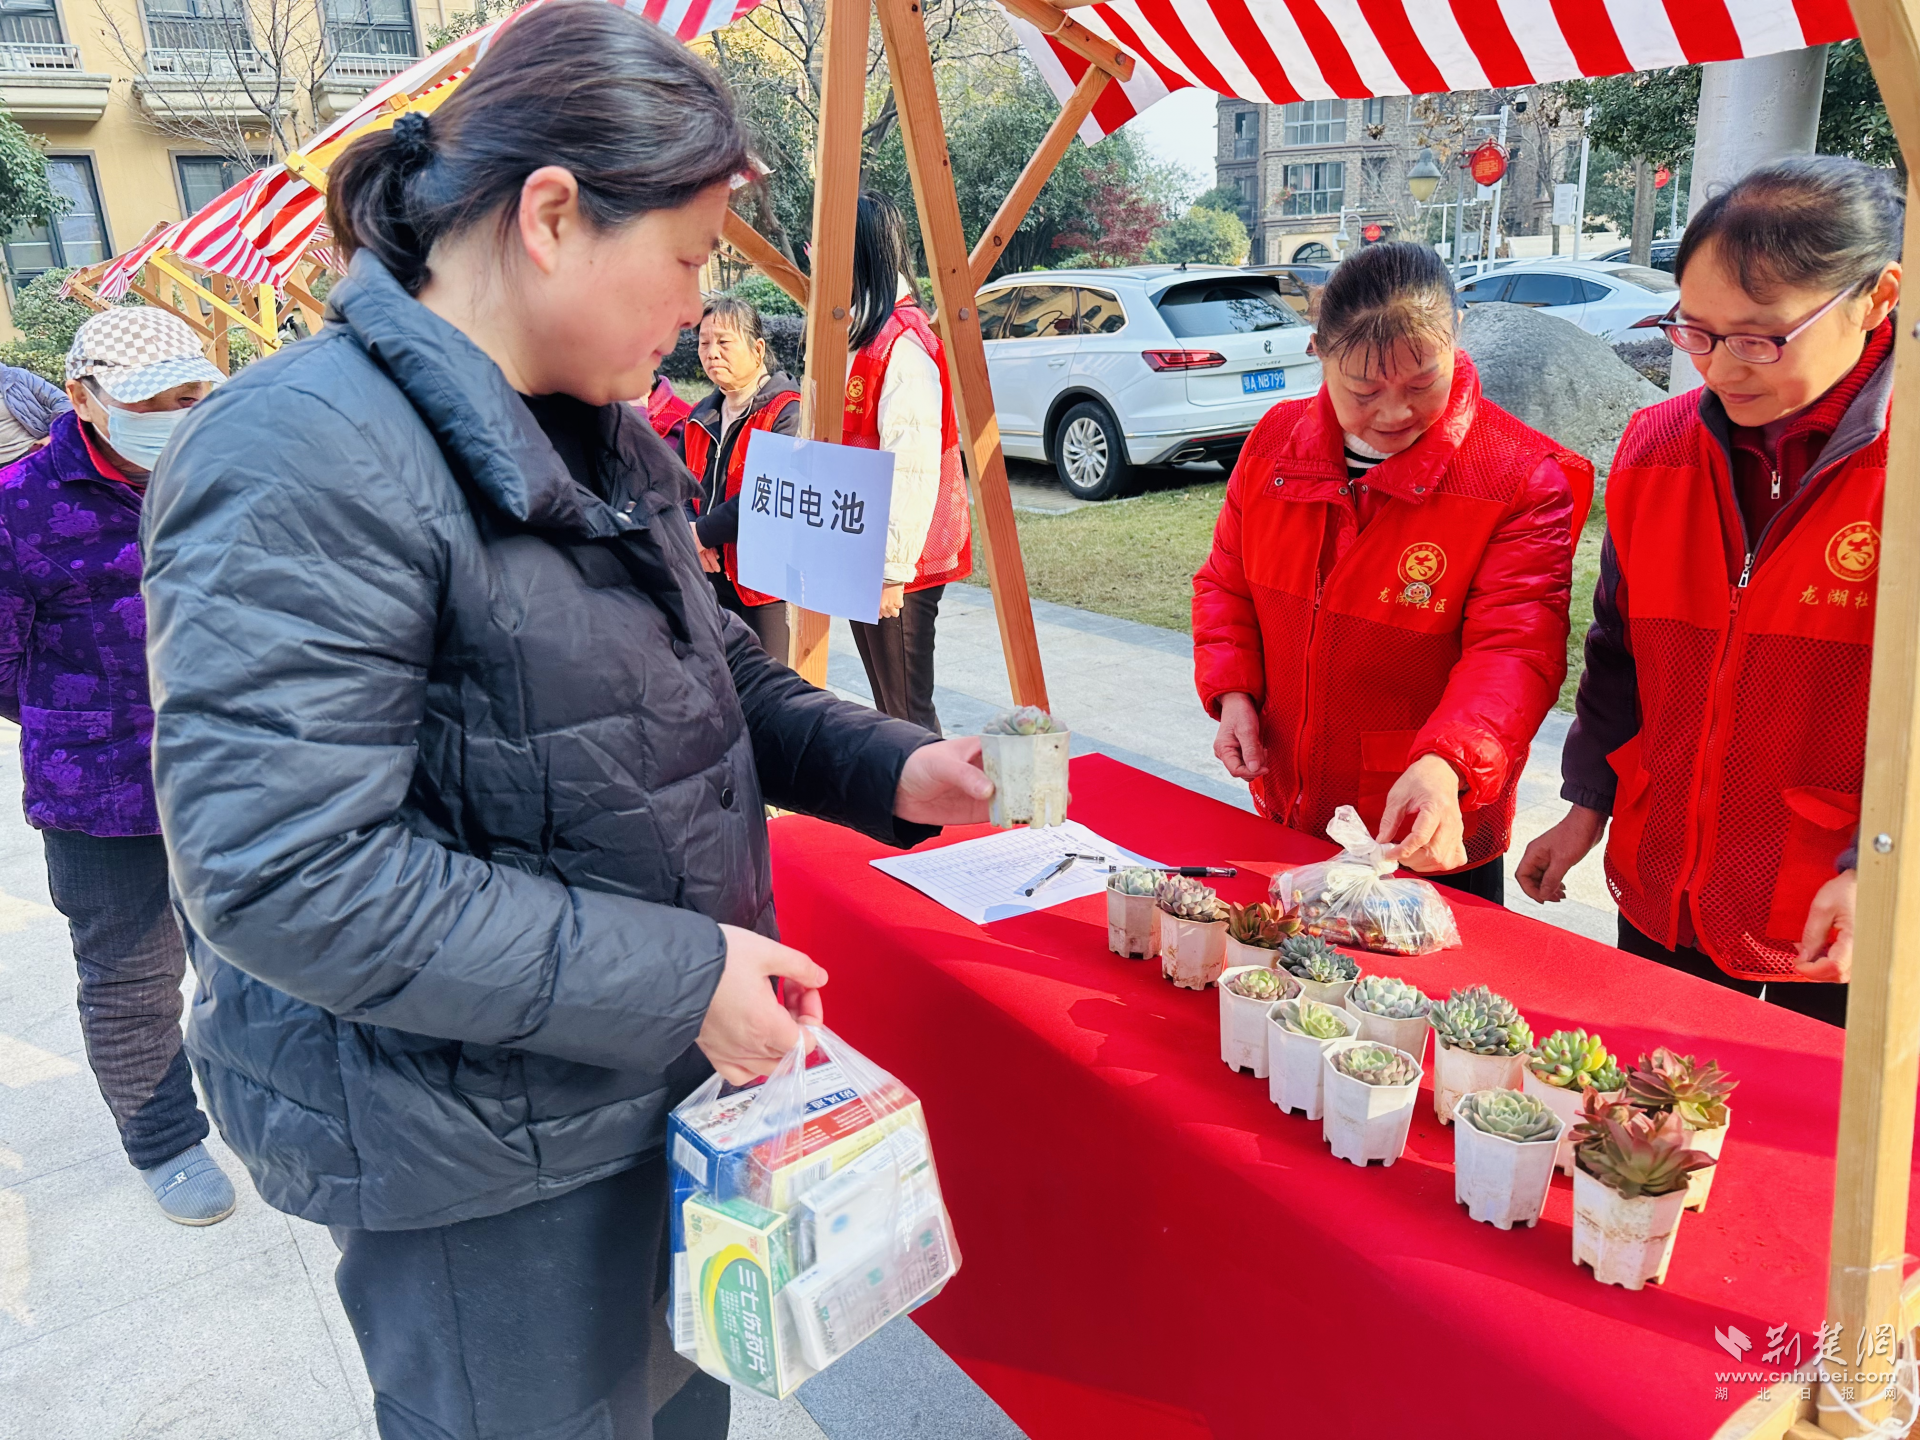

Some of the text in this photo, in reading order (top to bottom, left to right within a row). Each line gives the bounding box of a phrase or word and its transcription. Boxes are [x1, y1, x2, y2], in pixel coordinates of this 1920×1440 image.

[751, 473, 865, 535] 废旧电池
[738, 1264, 767, 1375] 三七伤药片
